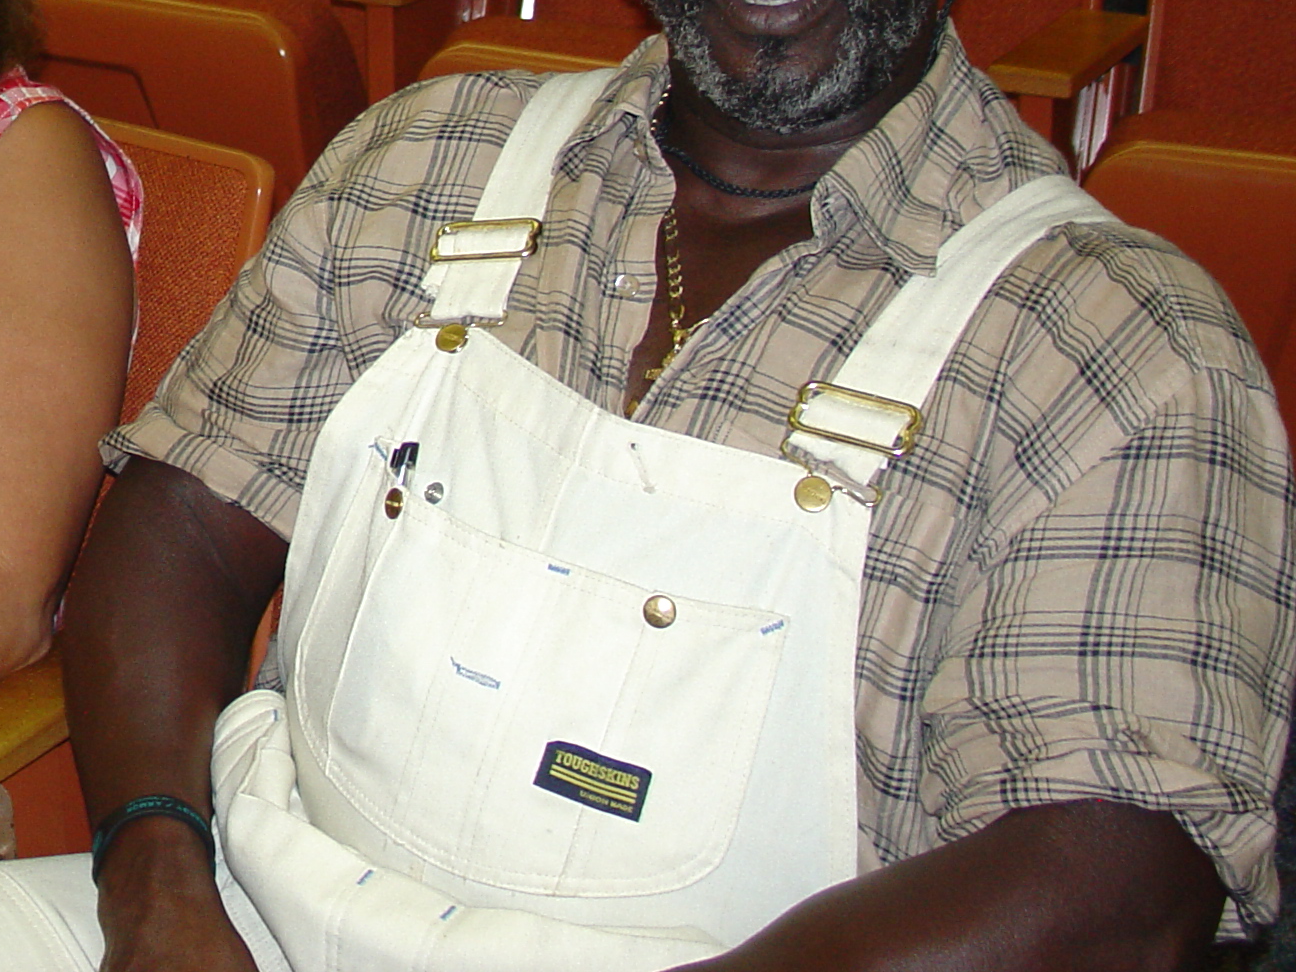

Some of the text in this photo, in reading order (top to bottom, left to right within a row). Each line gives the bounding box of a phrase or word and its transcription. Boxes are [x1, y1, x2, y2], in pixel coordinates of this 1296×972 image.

[555, 750, 641, 790] TOUGHSKINS
[579, 790, 633, 813] UNION MADE
